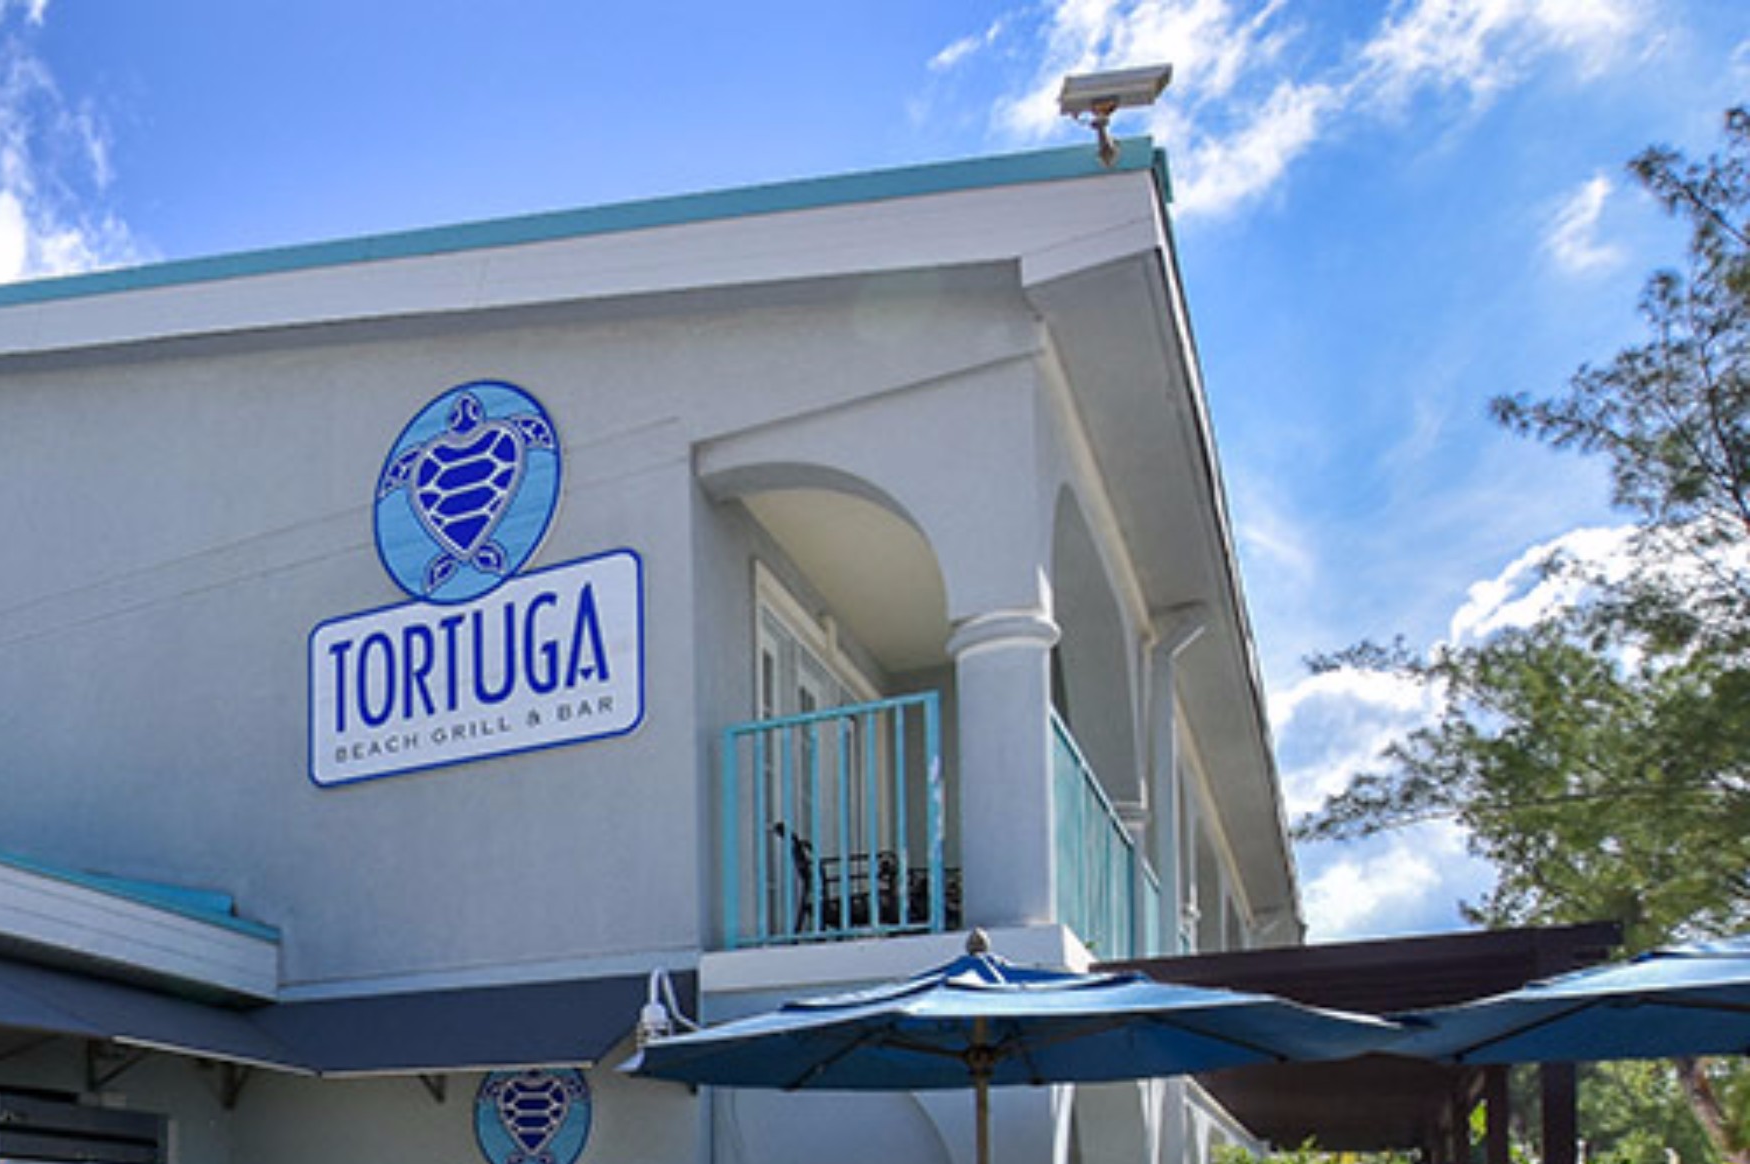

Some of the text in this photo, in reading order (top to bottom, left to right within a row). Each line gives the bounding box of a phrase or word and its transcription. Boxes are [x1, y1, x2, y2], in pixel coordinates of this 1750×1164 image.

[329, 583, 610, 734] TORTUGA
[335, 696, 614, 764] BEACH GRILL & BAR
